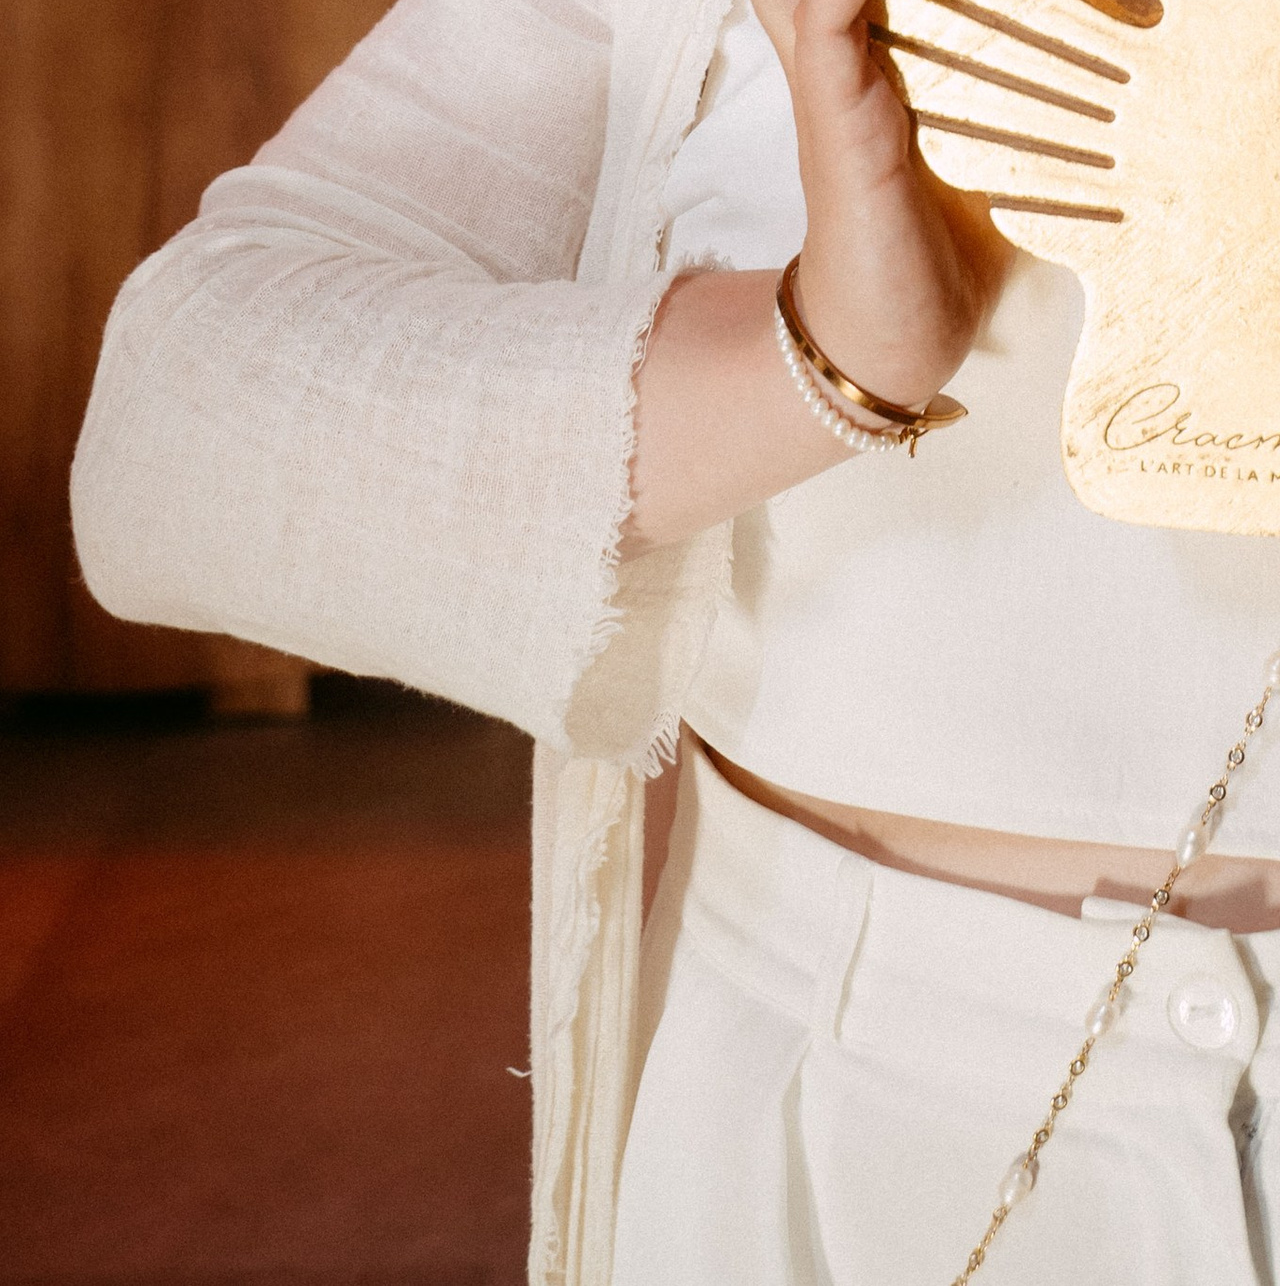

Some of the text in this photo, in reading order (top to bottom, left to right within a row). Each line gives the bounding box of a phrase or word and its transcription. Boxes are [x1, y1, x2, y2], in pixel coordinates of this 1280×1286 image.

[1140, 459, 1195, 476] L'ART
[1204, 465, 1229, 480] DE
[1236, 467, 1259, 482] LA
